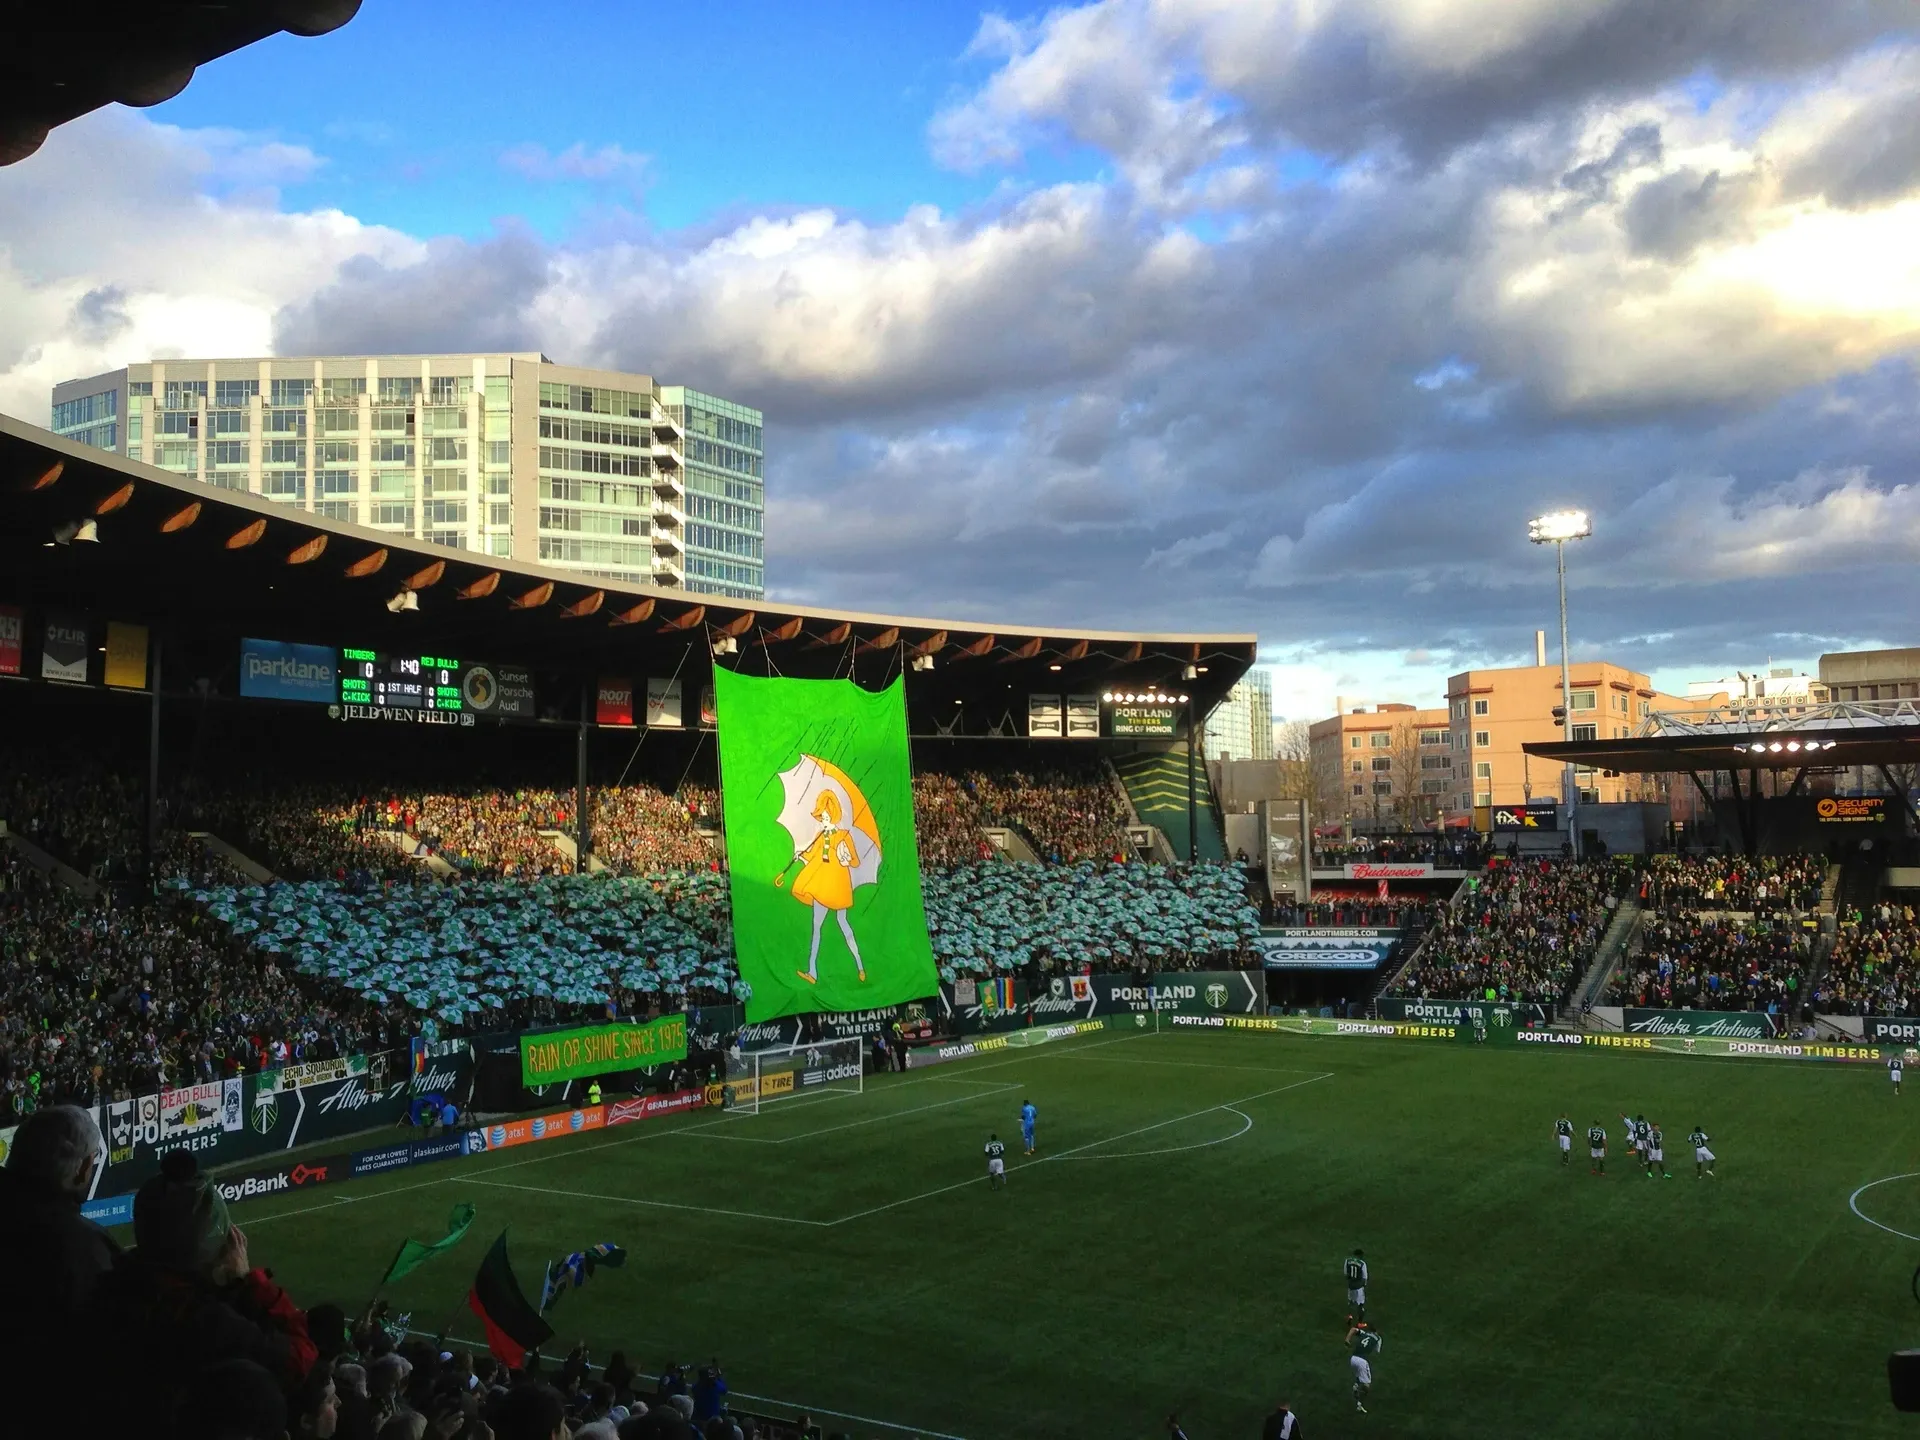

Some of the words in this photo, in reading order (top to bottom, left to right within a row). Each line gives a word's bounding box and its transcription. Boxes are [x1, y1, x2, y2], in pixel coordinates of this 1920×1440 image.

[343, 648, 376, 661] TIMBERS
[250, 655, 330, 680] parklane
[421, 656, 434, 667] RED
[437, 658, 458, 669] BULLS
[365, 662, 373, 678] 0
[441, 669, 449, 684] 0
[498, 670, 528, 684] Sunset
[343, 679, 366, 690] SHOTS
[388, 683, 401, 692] 1ST
[404, 684, 421, 693] HALF
[437, 687, 458, 698] SHOTS
[498, 685, 534, 699] Porsche
[598, 689, 632, 701] ROOT
[498, 700, 520, 711] Audi
[417, 710, 458, 725] FIELD
[1115, 708, 1173, 719] PORTLAND
[1115, 725, 1133, 733] RING
[1145, 726, 1173, 734] HONOR
[1837, 799, 1885, 807] SECURITY
[1495, 810, 1521, 825] fix
[1838, 807, 1869, 816] SIGNS
[1352, 864, 1425, 879] Budweiser
[1276, 952, 1365, 960] OREGON
[1129, 1000, 1181, 1011] TIMERS
[835, 1022, 883, 1036] TIMBERS
[1172, 1015, 1224, 1026] PORTLAND
[1225, 1018, 1278, 1029] TIMBERS
[1629, 1015, 1691, 1035] Alaska
[1695, 1018, 1762, 1039] Airlines
[1046, 1025, 1076, 1039] PORTLAND
[1076, 1020, 1104, 1033] TIMBERS
[1337, 1022, 1394, 1036] PORTLAND
[1397, 1025, 1456, 1038] TIMBERS
[1517, 1031, 1582, 1044] PORTLAND
[1583, 1035, 1652, 1048] TIMBERS
[527, 1041, 561, 1073] RAIN
[563, 1037, 581, 1068] OR
[584, 1031, 621, 1064] SHINE
[622, 1028, 656, 1059] SINCE
[658, 1022, 684, 1051] 1975
[939, 1044, 975, 1058] PORTLAND
[973, 1037, 1008, 1052] TIMBERS
[1729, 1042, 1801, 1055] PORTLAND
[1803, 1045, 1880, 1060] TIMBERS
[284, 1066, 304, 1080] ECHO
[305, 1058, 345, 1076] SQUADRON
[826, 1062, 861, 1081] adidas
[772, 1076, 793, 1089] TIRE
[161, 1089, 190, 1110] DEAD
[192, 1084, 221, 1102] BULL
[647, 1099, 668, 1111] GRAB
[547, 1118, 564, 1131] at&t
[586, 1111, 601, 1124] at&t
[507, 1126, 525, 1138] at&t
[362, 1155, 374, 1163] FOR
[374, 1152, 387, 1161] OUR
[387, 1149, 409, 1158] LOWEST
[413, 1142, 460, 1158] alaskaair.com
[355, 1163, 372, 1172] FARES
[372, 1156, 409, 1170] GUARANTEED
[214, 1172, 290, 1202] KeyBank
